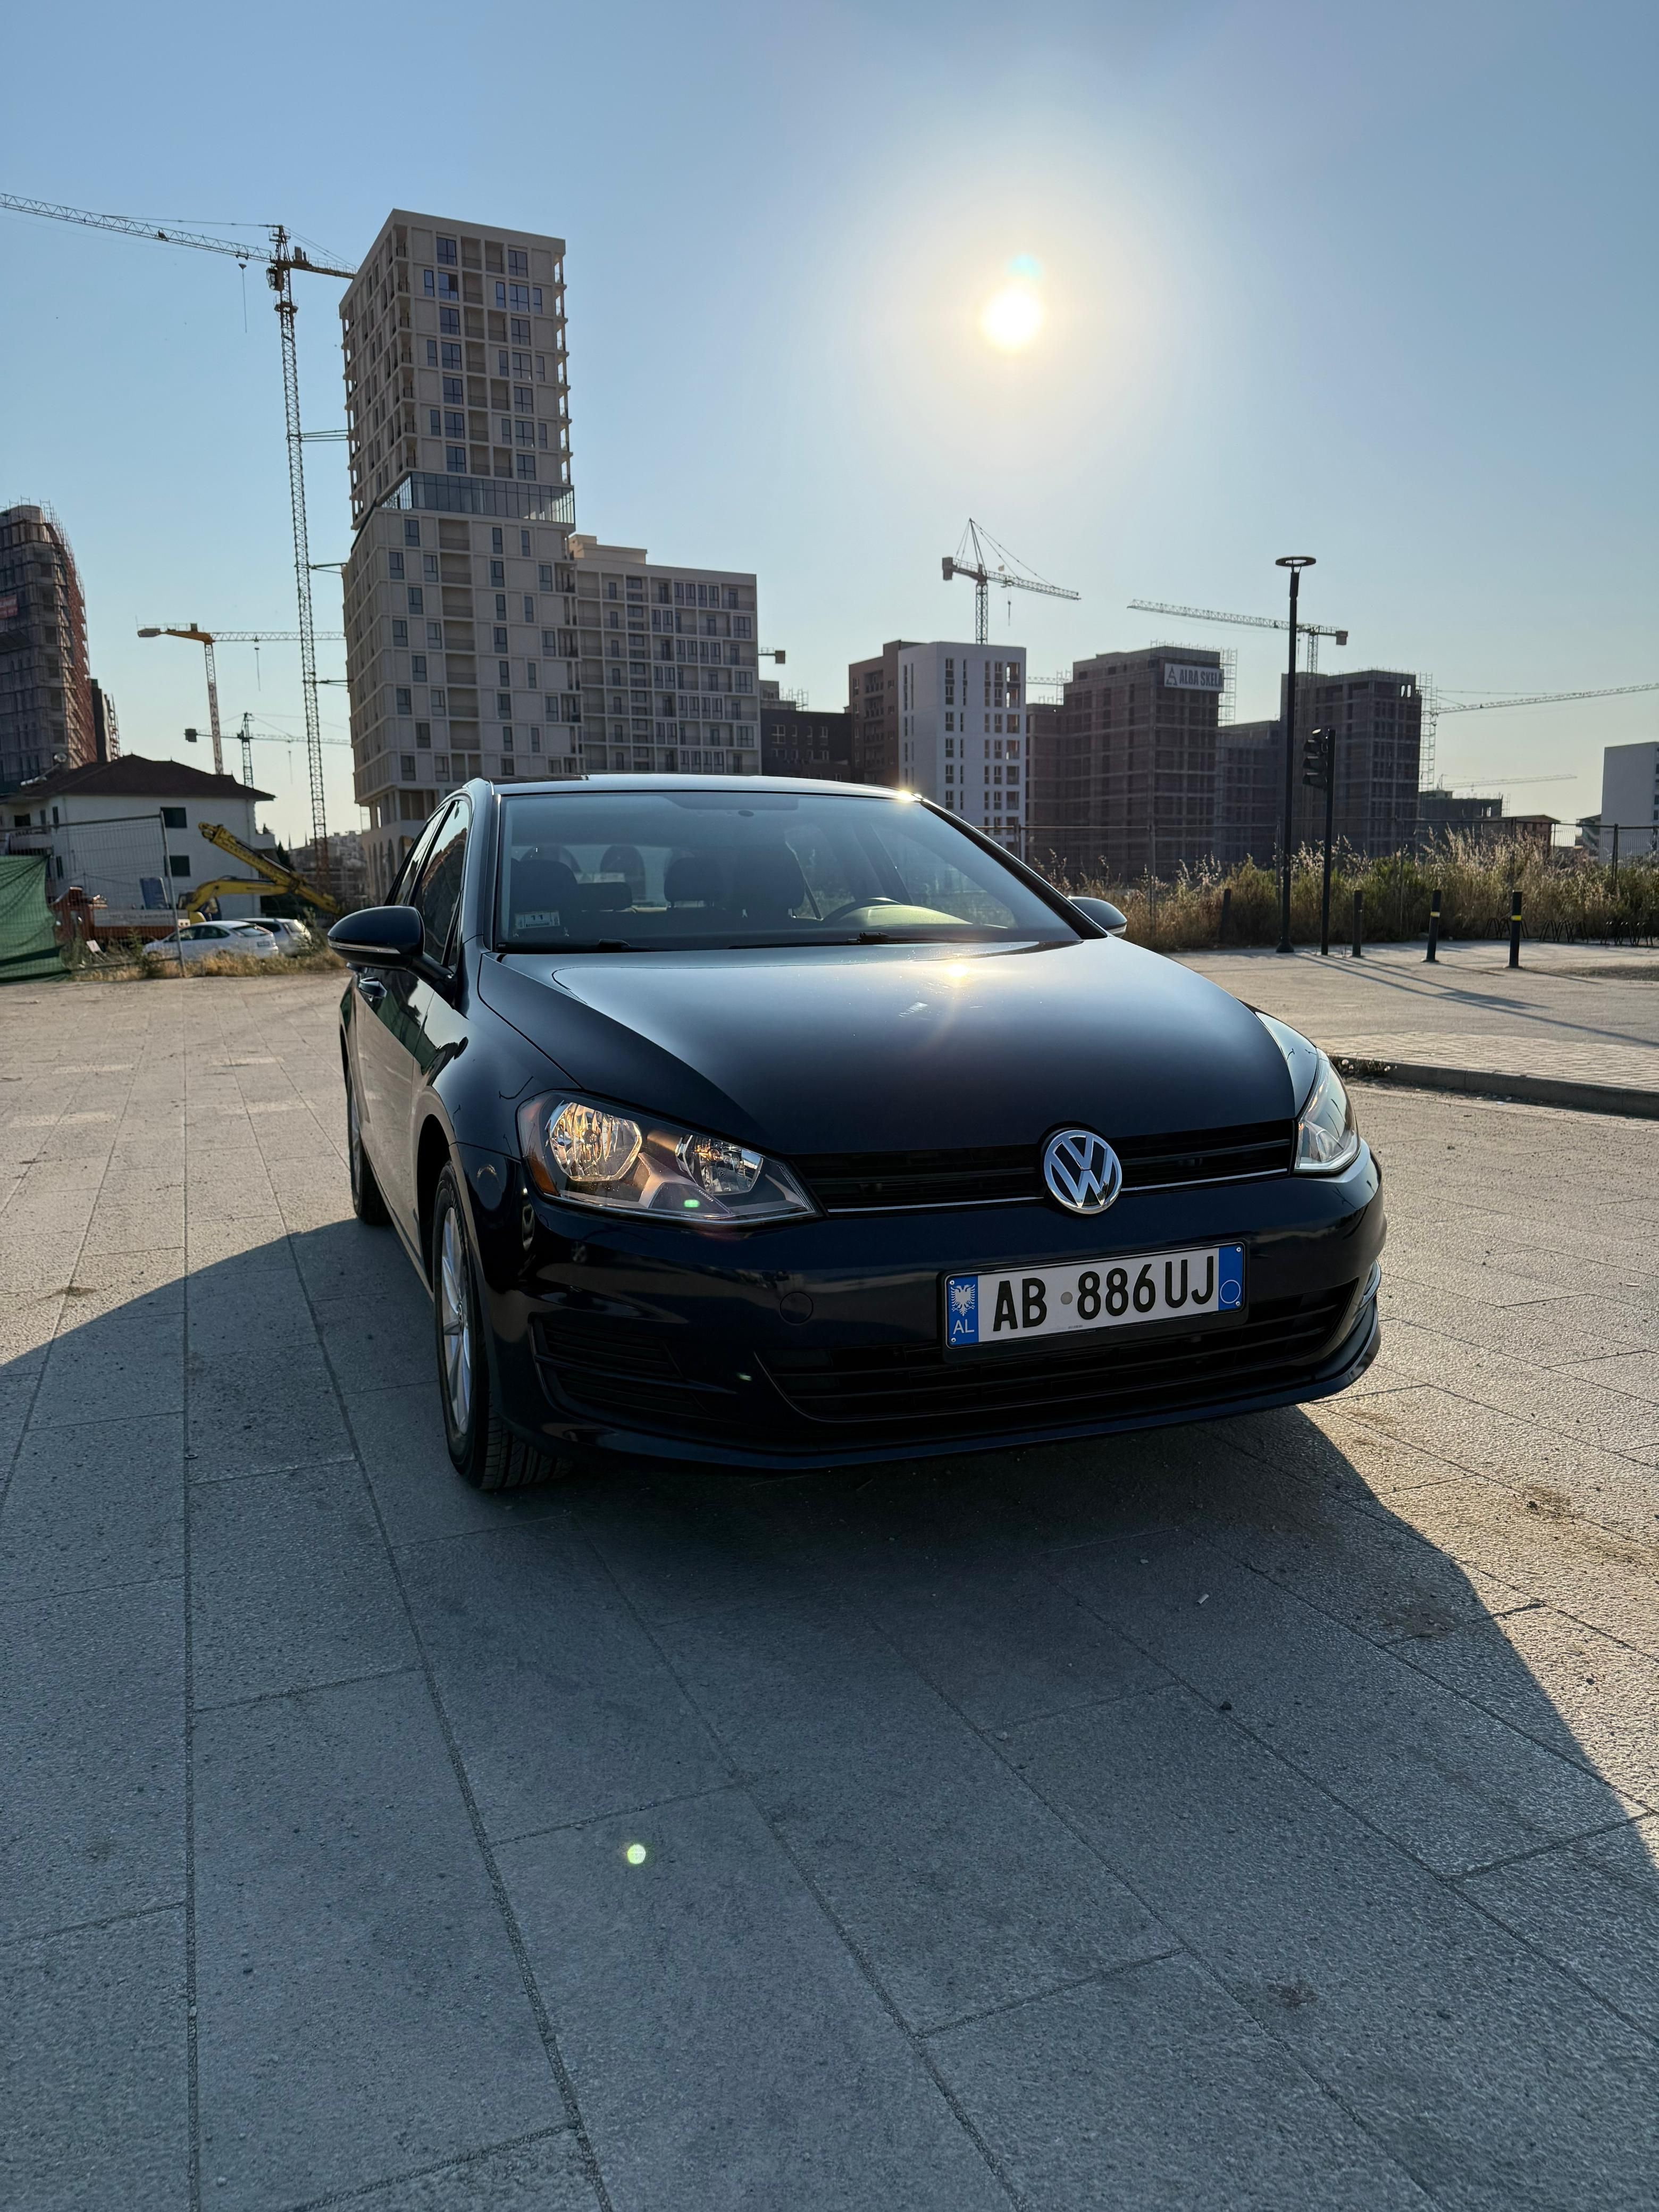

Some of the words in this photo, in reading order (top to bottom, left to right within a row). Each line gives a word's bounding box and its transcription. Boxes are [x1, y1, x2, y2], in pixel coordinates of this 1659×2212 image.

[1179, 668, 1199, 685] ALBA
[1045, 1133, 1118, 1208] VW
[993, 1277, 1047, 1331] AB
[953, 1320, 975, 1335] AL
